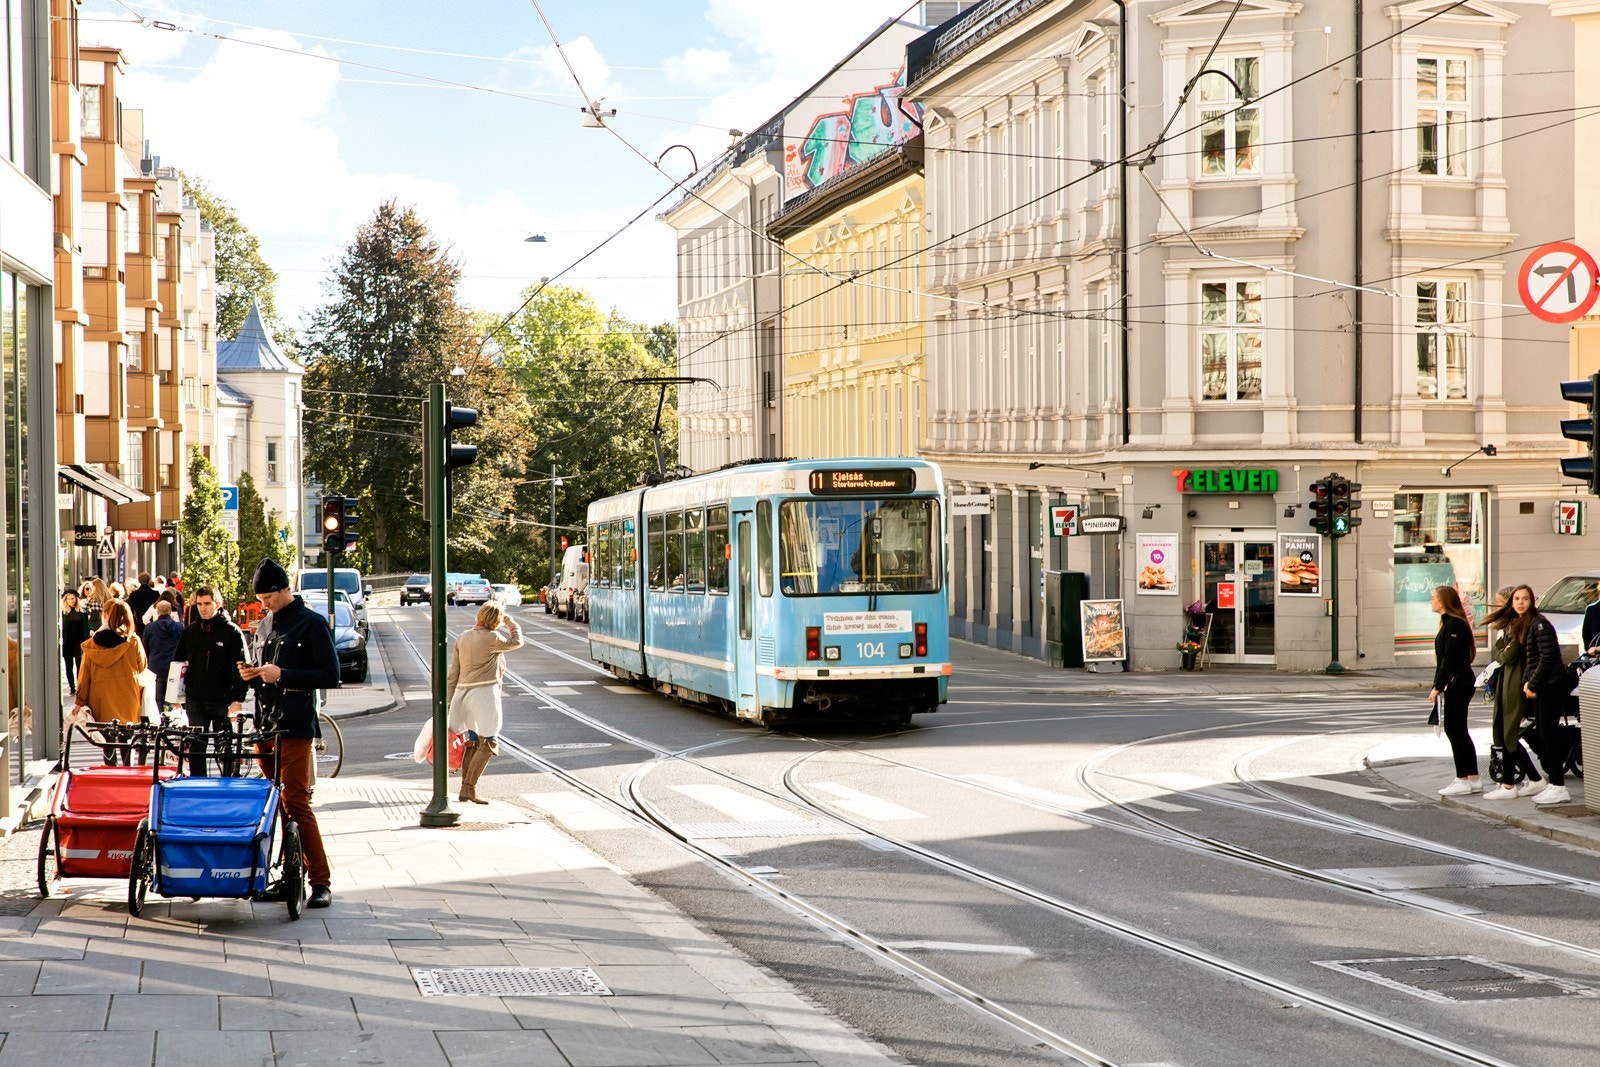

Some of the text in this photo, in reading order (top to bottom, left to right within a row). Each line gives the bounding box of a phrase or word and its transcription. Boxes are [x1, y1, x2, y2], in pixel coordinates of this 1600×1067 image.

[811, 473, 823, 489] 11
[832, 472, 864, 481] Kjelsås
[1085, 520, 1118, 529] MINIBANK
[1285, 542, 1315, 550] PANINI
[856, 642, 886, 658] 104
